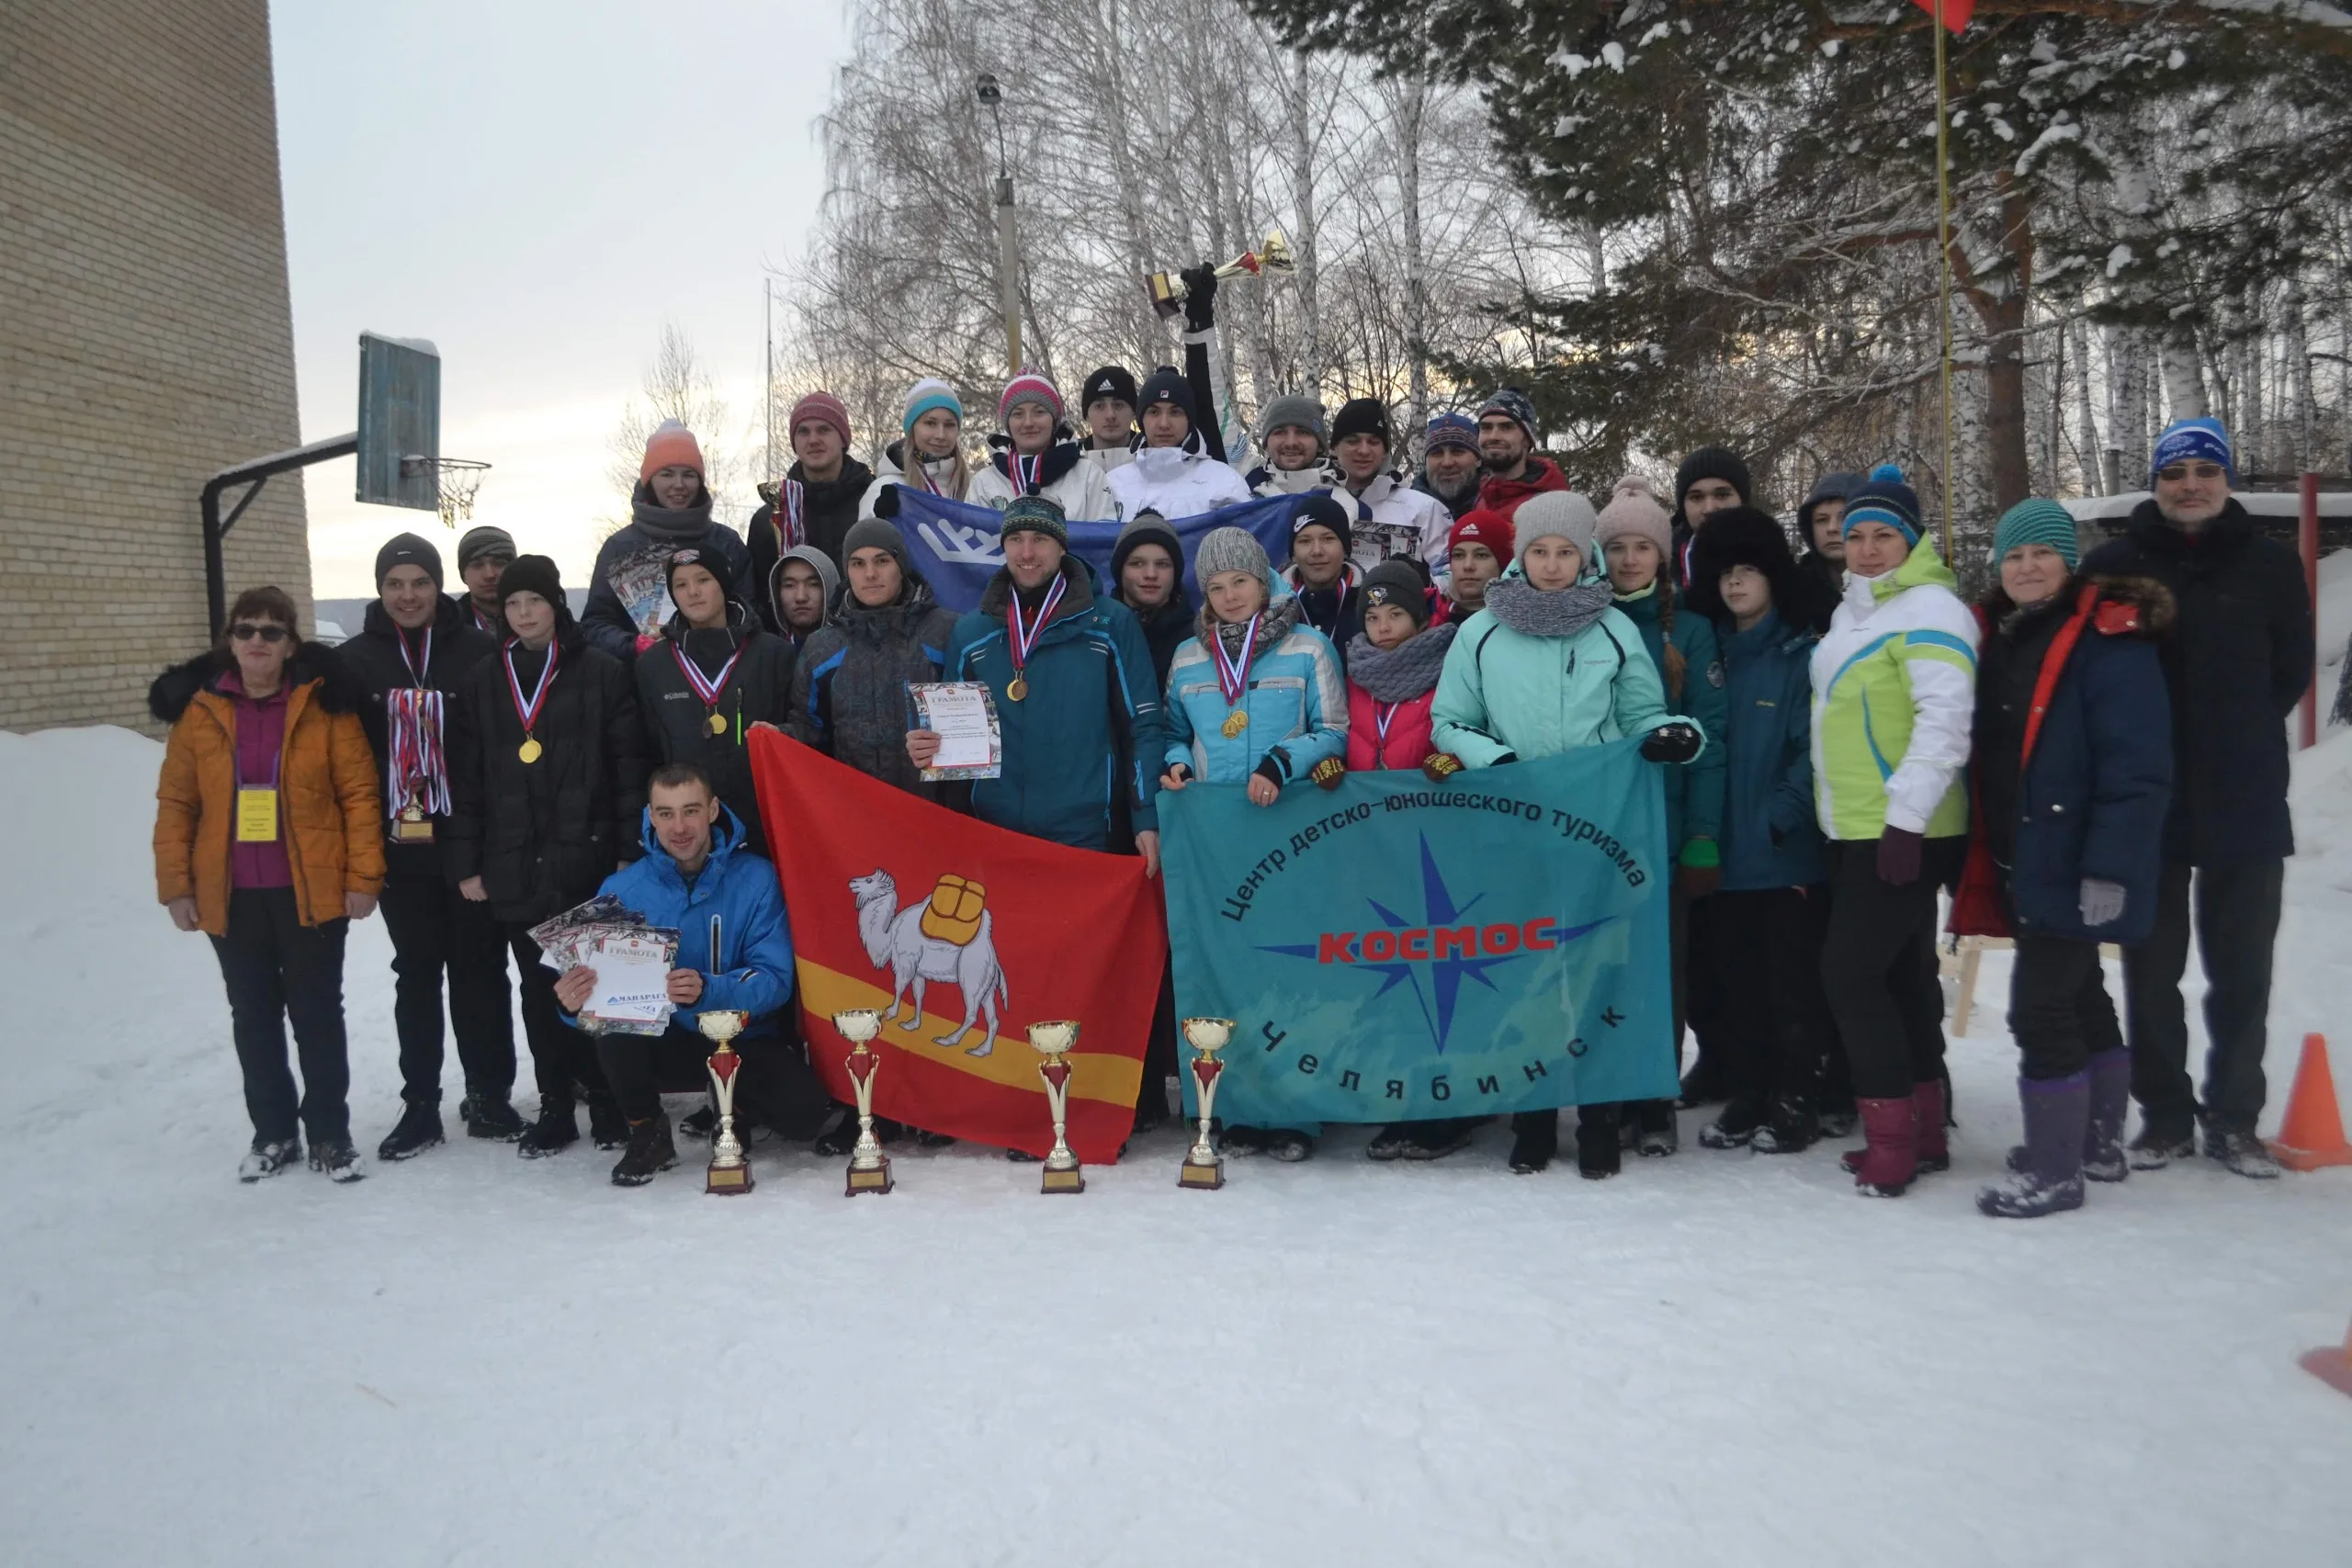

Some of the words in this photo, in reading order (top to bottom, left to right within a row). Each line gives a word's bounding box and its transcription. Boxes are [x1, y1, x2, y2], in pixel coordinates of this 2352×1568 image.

[1220, 848, 1286, 922] Центр
[1289, 791, 1543, 857] детско-юношеского
[1552, 808, 1646, 887] туризма
[609, 947, 658, 958] ГРАМОТА
[1317, 917, 1556, 964] КОСМОС
[1261, 1006, 1626, 1100] Челябинск
